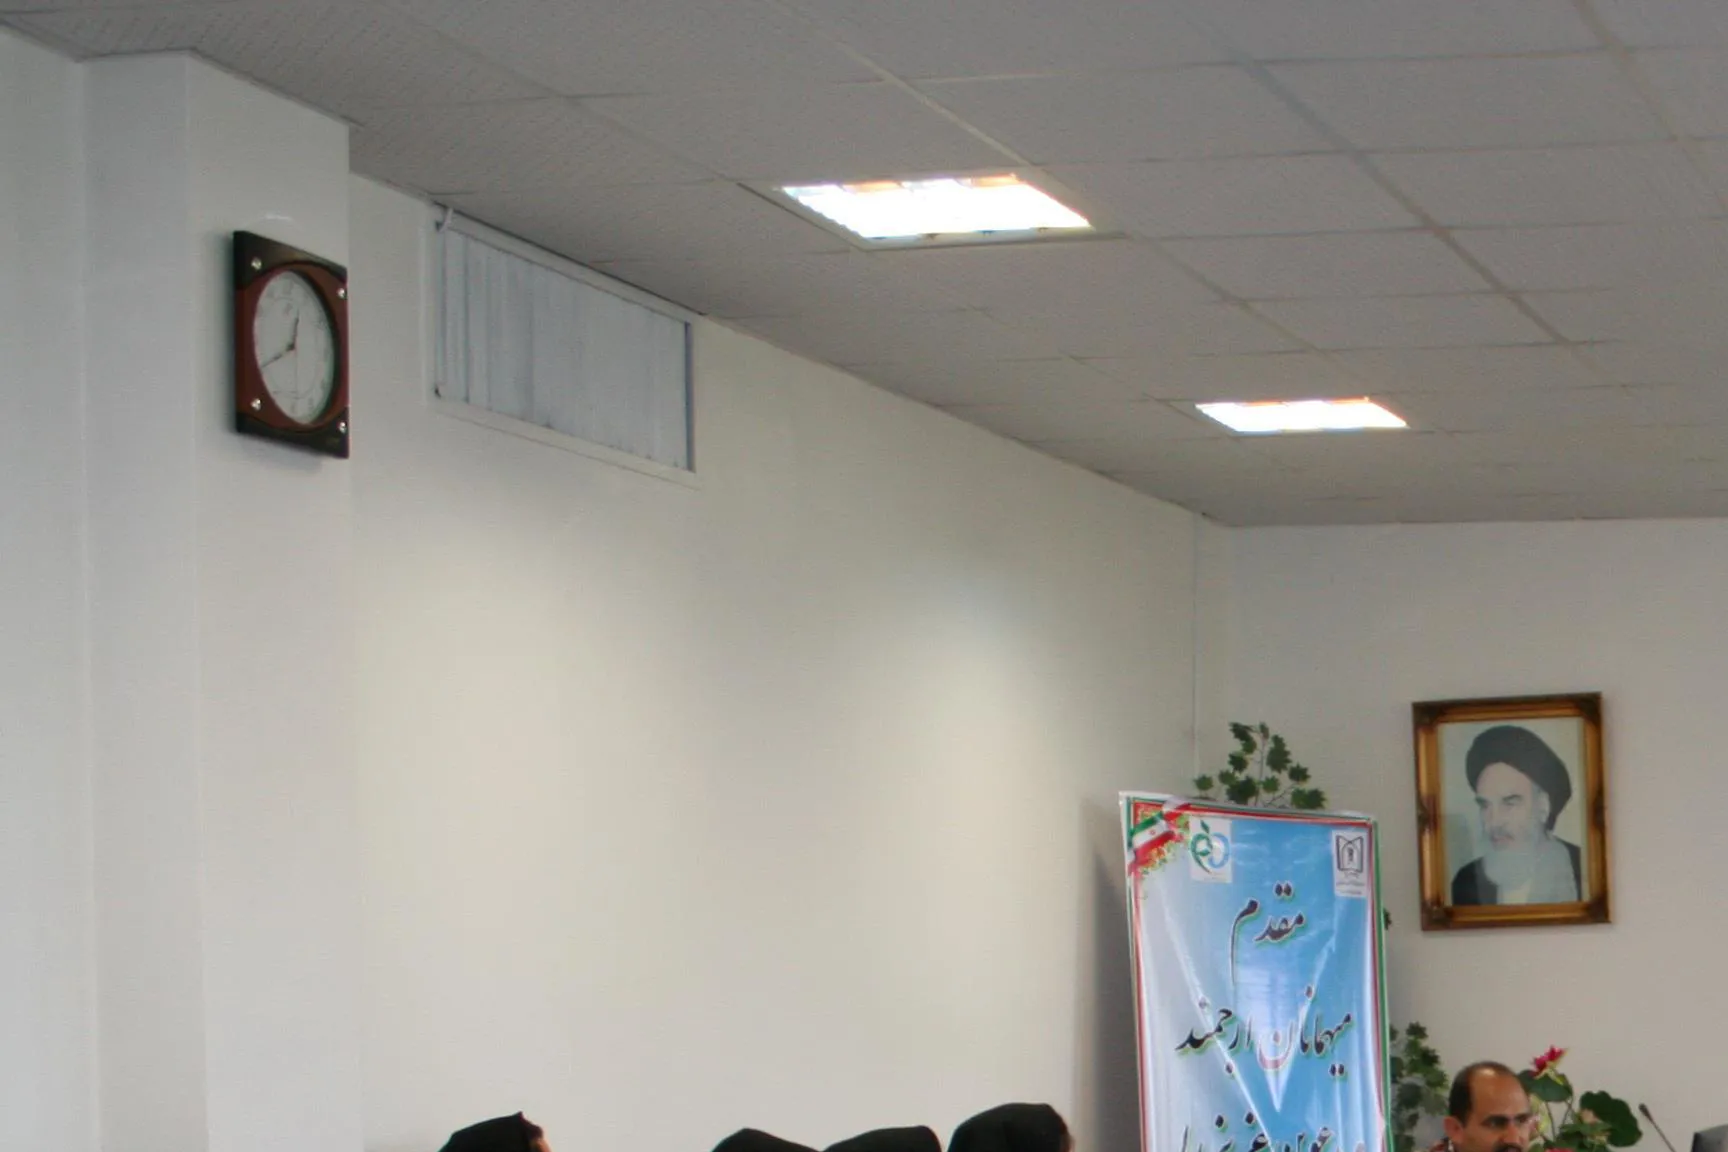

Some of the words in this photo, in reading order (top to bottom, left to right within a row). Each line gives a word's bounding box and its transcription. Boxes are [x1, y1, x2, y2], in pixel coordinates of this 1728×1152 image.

[1230, 881, 1305, 987] مقدم
[1175, 997, 1252, 1074] ارجمند
[1256, 984, 1352, 1077] میهمانان
